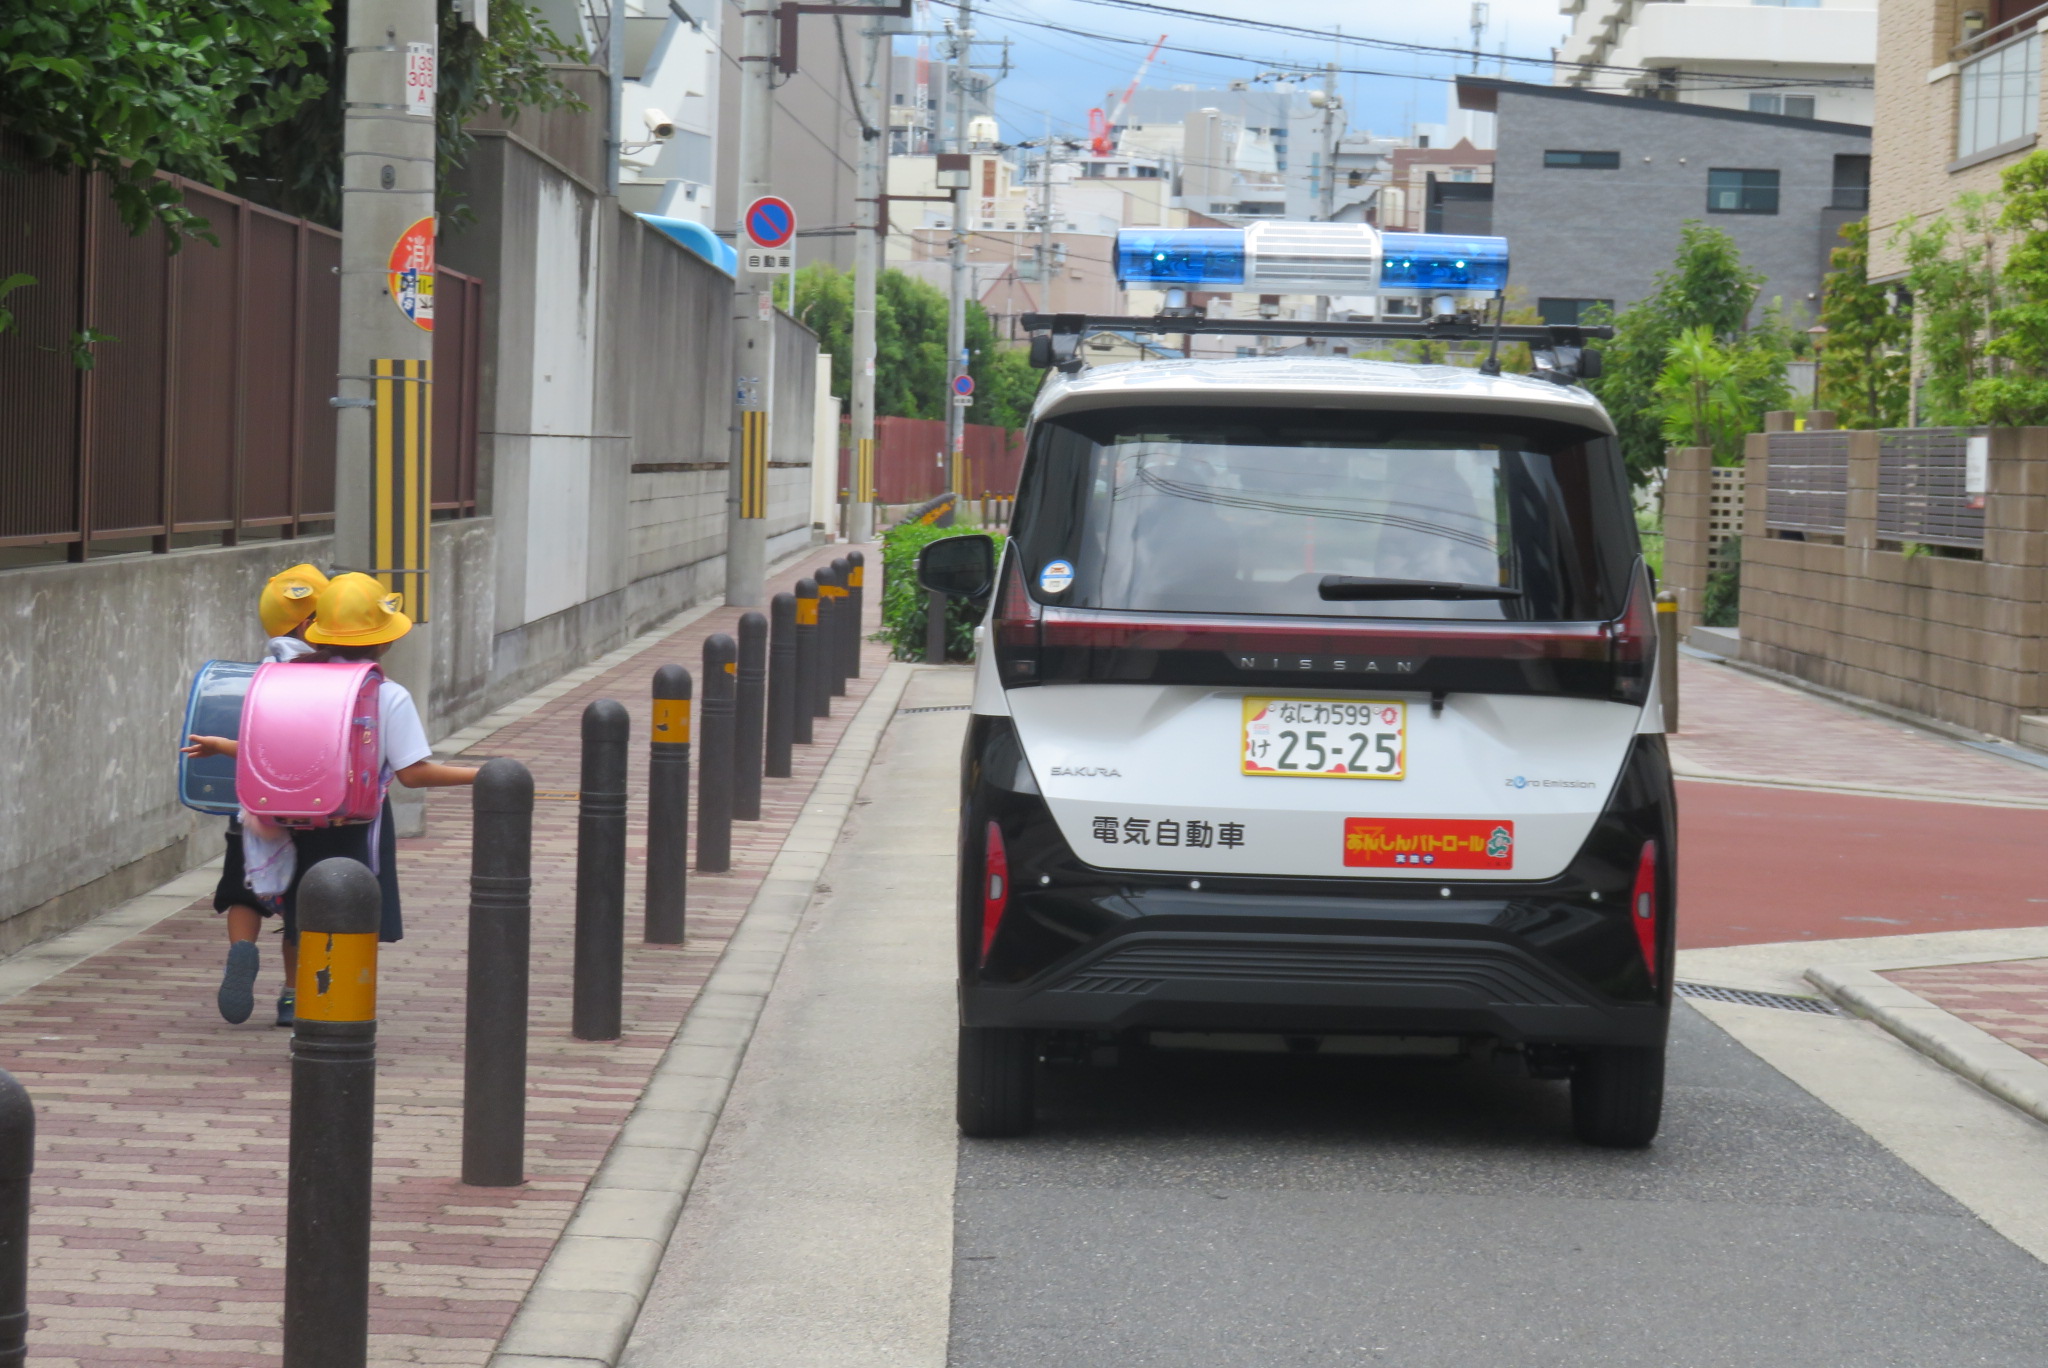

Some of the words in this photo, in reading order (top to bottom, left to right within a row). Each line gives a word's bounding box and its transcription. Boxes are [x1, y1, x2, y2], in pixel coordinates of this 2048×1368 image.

[407, 72, 433, 88] 303
[417, 88, 426, 102] A
[749, 255, 790, 268] 自動車
[1240, 657, 1411, 672] NISSAN
[1279, 702, 1371, 726] なにわ599
[1250, 739, 1271, 759] け
[1278, 730, 1397, 773] 25-25
[1050, 766, 1122, 777] SAKURA
[1542, 779, 1596, 789] Emission
[1092, 815, 1246, 850] 電気自動車
[1346, 833, 1485, 852] あんしんパトロール
